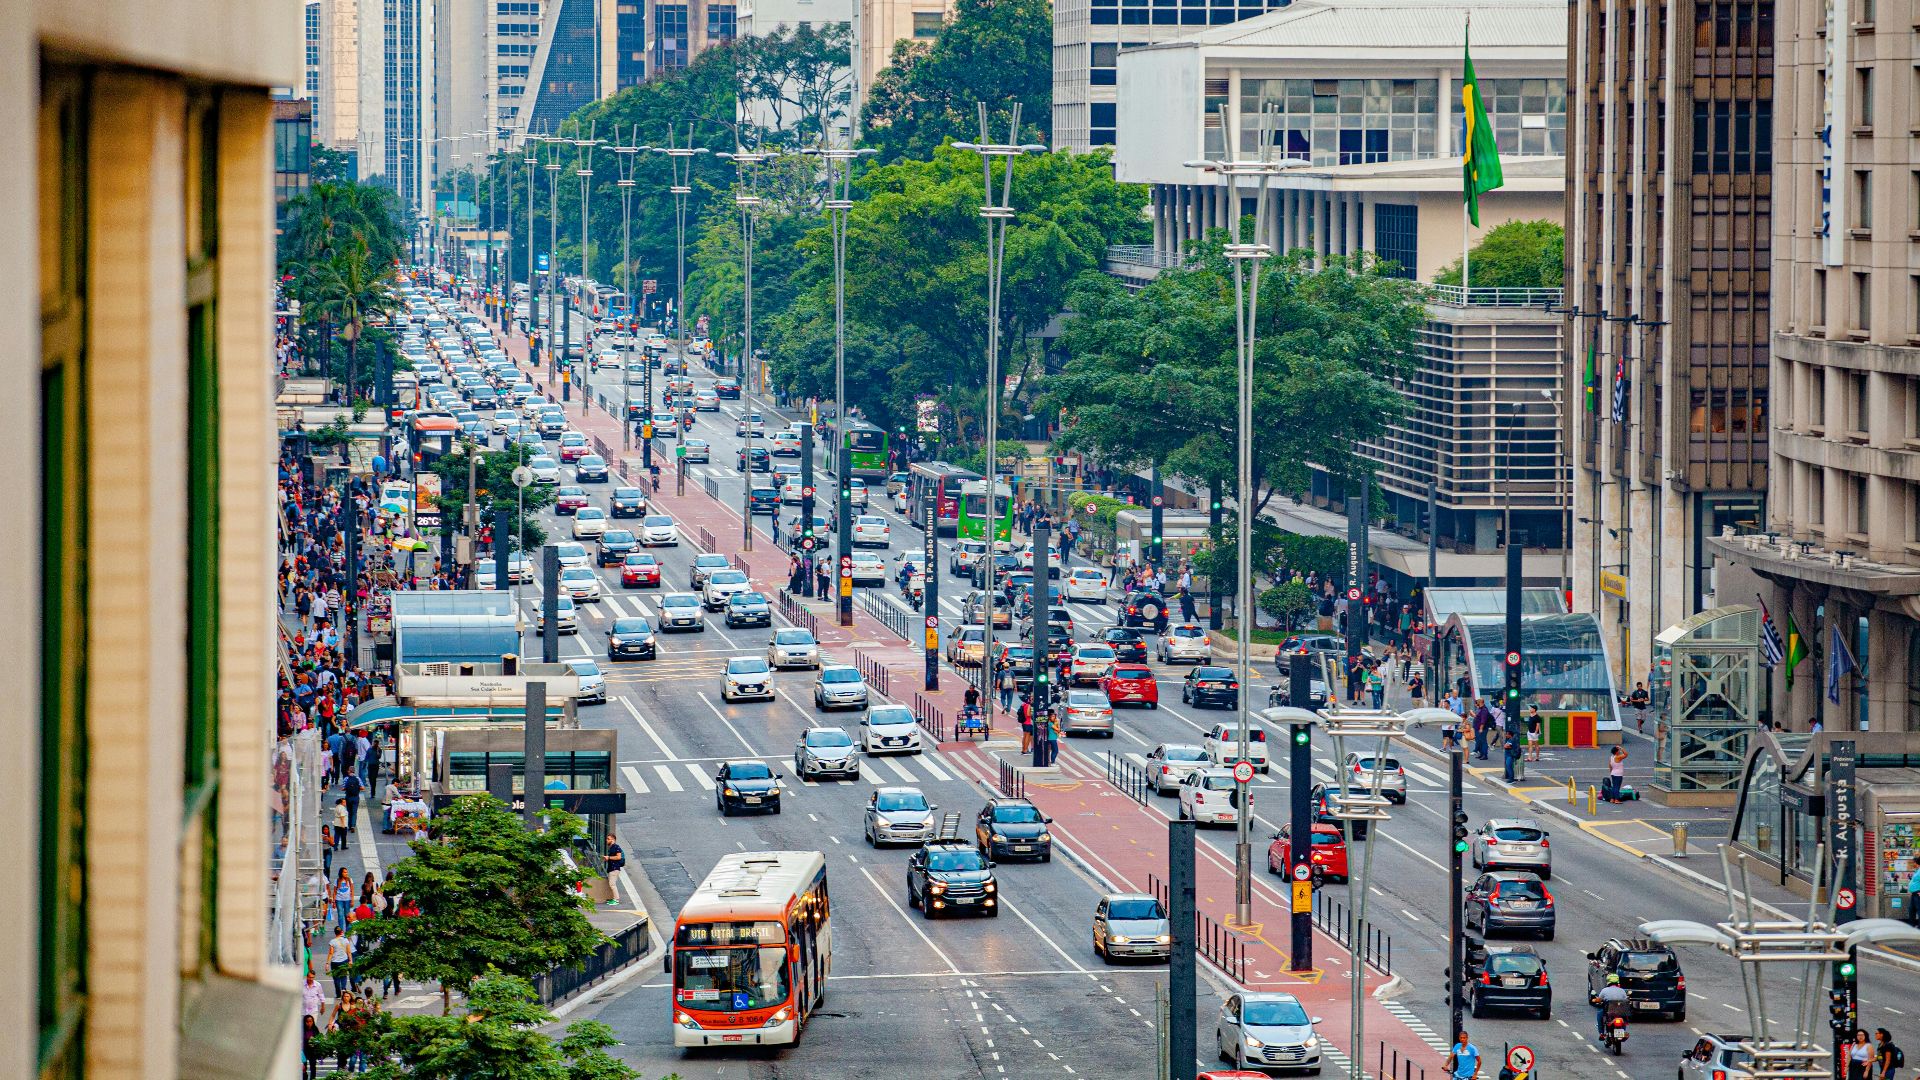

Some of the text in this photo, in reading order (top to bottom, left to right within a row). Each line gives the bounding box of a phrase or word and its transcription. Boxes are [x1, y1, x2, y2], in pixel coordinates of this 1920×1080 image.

[417, 517, 439, 526] 26°C
[925, 507, 934, 537] Manuel
[925, 539, 934, 559] João
[926, 561, 934, 573] Pe.
[1349, 542, 1358, 586] R. Augusta
[1835, 779, 1849, 841] Augusta
[690, 929, 707, 939] VIA
[740, 927, 770, 938] BRASIL
